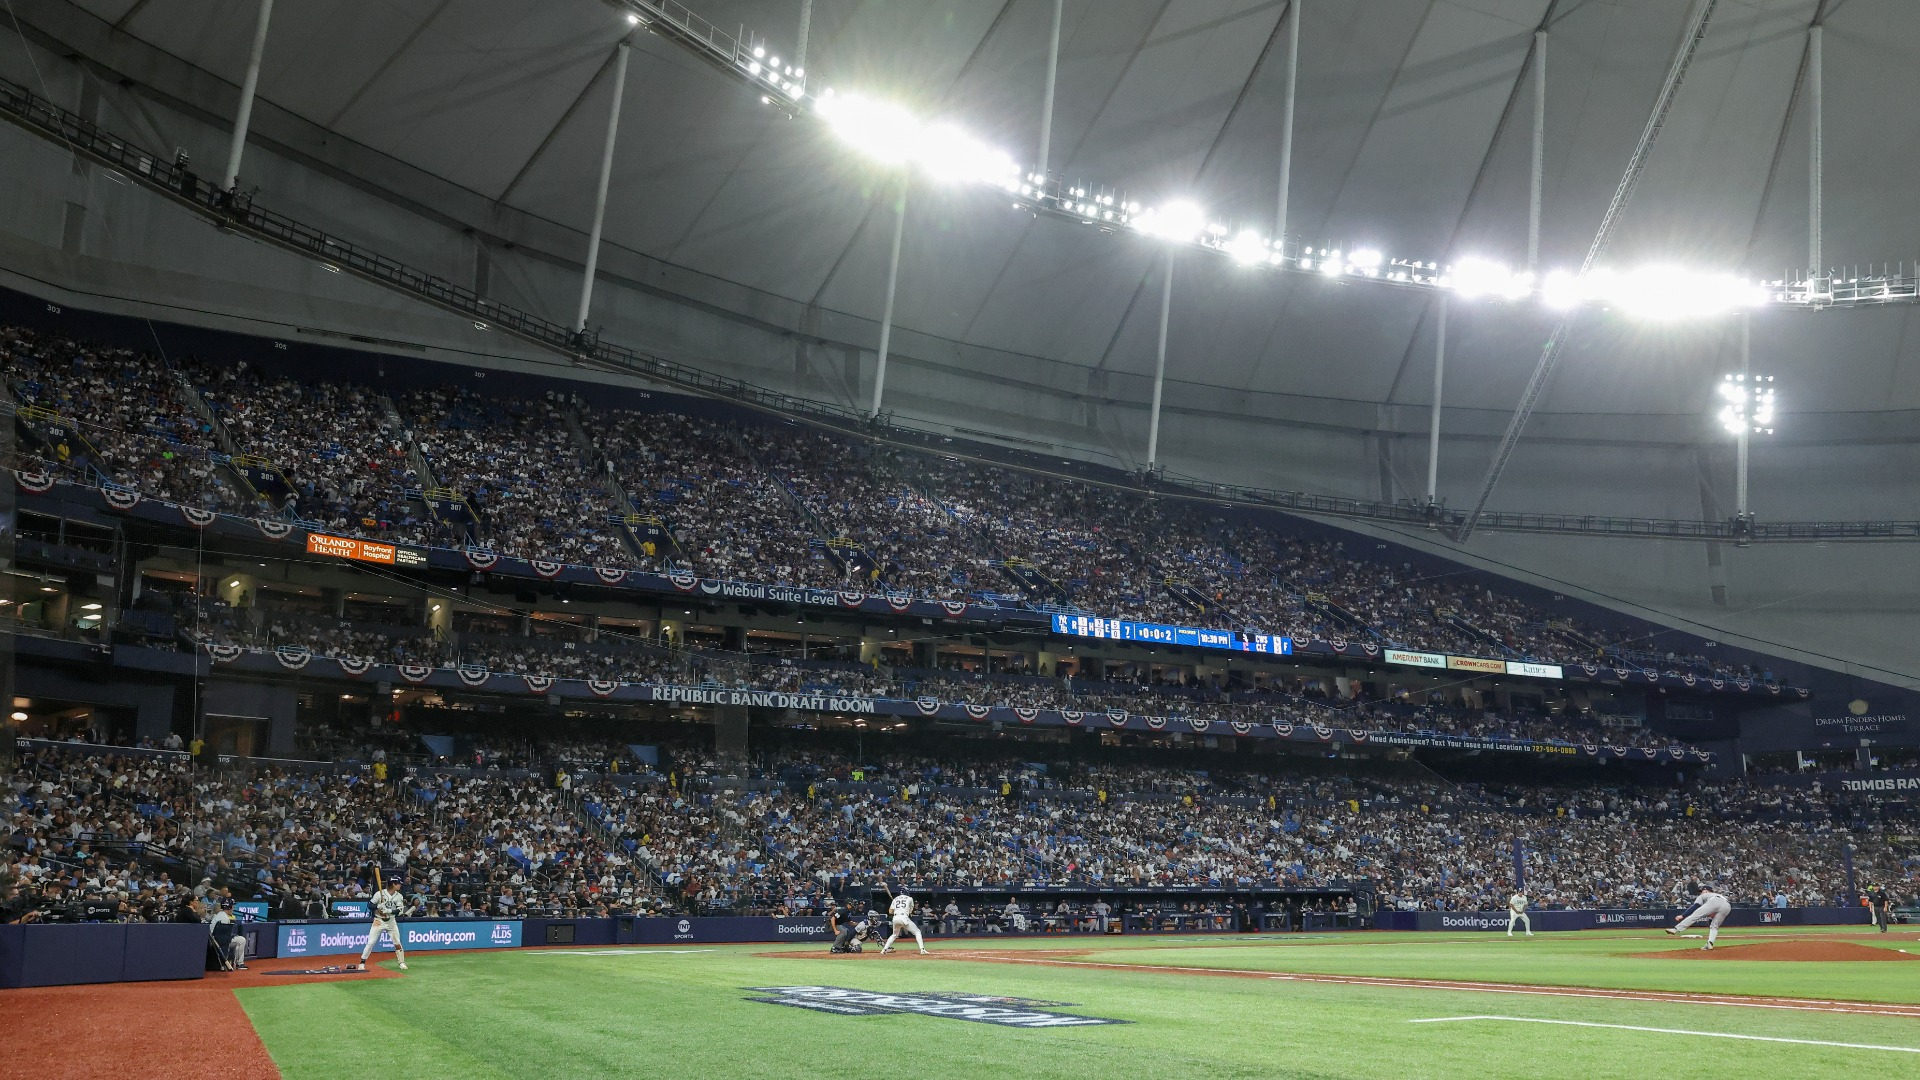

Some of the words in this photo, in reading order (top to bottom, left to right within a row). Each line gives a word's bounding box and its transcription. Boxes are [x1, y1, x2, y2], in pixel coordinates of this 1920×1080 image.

[47, 304, 61, 314] 303
[49, 427, 64, 437] 303
[261, 472, 274, 481] 305
[450, 503, 462, 511] 307
[363, 544, 392, 554] Bayfront
[363, 550, 391, 560] Hospital
[722, 583, 765, 598] Webull
[768, 588, 802, 602] Suite
[804, 591, 838, 606] Level
[1218, 636, 1228, 645] PM
[1256, 643, 1267, 652] CLE
[1392, 653, 1423, 663] AMERANT
[1423, 656, 1439, 665] BANK
[652, 687, 726, 705] REPUBLIC
[731, 692, 775, 708] BANK
[778, 695, 825, 711] DRAFT
[829, 698, 875, 713] ROOM
[1815, 718, 1844, 726] DREAM
[1845, 716, 1877, 724] FINDERS
[1878, 714, 1906, 723] HOMES
[1842, 724, 1881, 733] TERRACE
[1369, 735, 1387, 743] Need
[1389, 736, 1430, 746] Assistance?
[1431, 738, 1446, 747] Text
[1447, 740, 1462, 748] Your
[1463, 741, 1481, 749] Issue
[1482, 742, 1494, 750] and
[1495, 743, 1523, 751] Location
[1841, 779, 1895, 791] SOMOS
[895, 899, 907, 909] 25
[1607, 913, 1625, 922] ALDS
[1771, 912, 1782, 922] APP
[491, 930, 512, 939] ALDS
[778, 924, 826, 935] Booking.co
[287, 935, 307, 947] ALDS
[408, 930, 476, 944] Booking.com
